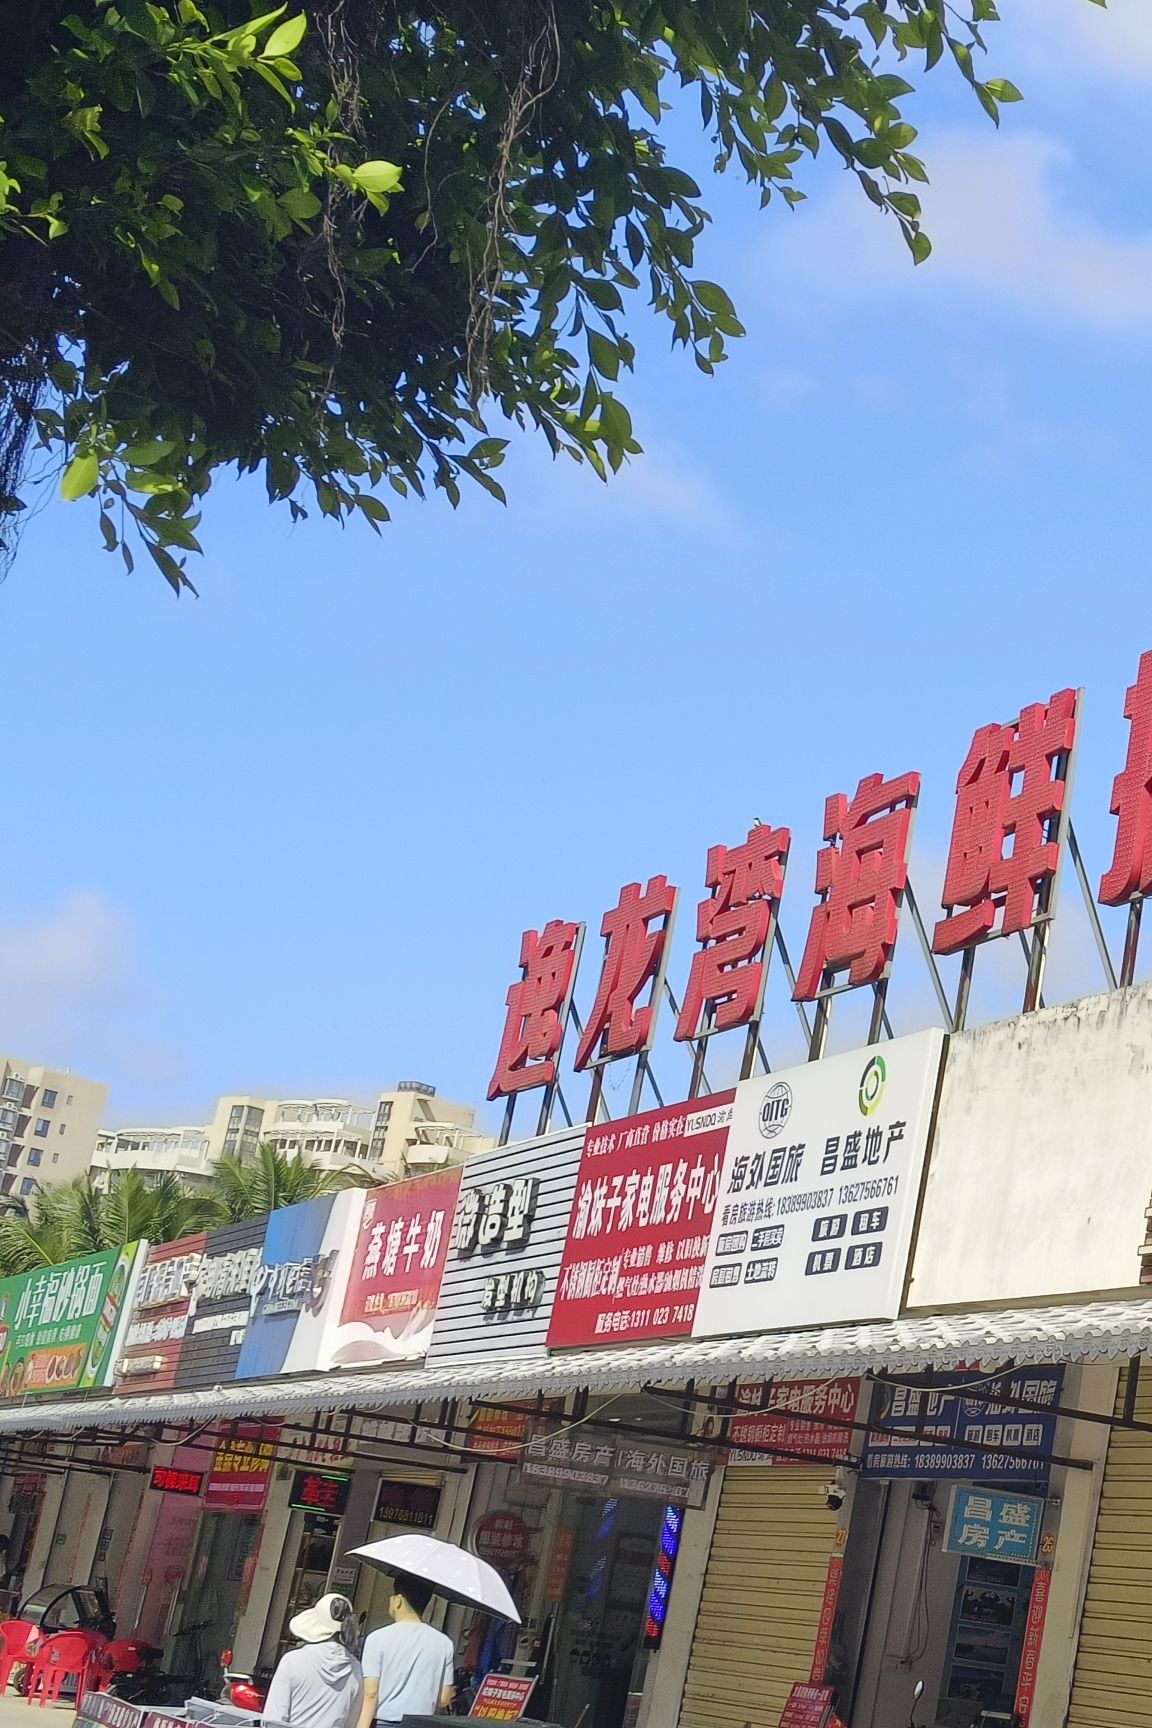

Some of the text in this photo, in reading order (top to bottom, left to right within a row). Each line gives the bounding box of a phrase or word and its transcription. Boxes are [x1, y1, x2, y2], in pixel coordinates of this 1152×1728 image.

[726, 1121, 906, 1194] 海外国旅 昌盛地产
[852, 1246, 876, 1267] 酒店
[653, 1307, 668, 1325] 023
[671, 1304, 695, 1324] 7418
[527, 1434, 711, 1481] 昌盛房产 海外国旅
[914, 1453, 975, 1469] 18389903837
[964, 1496, 1030, 1527] 昌盛
[958, 1522, 1027, 1551] 房产
